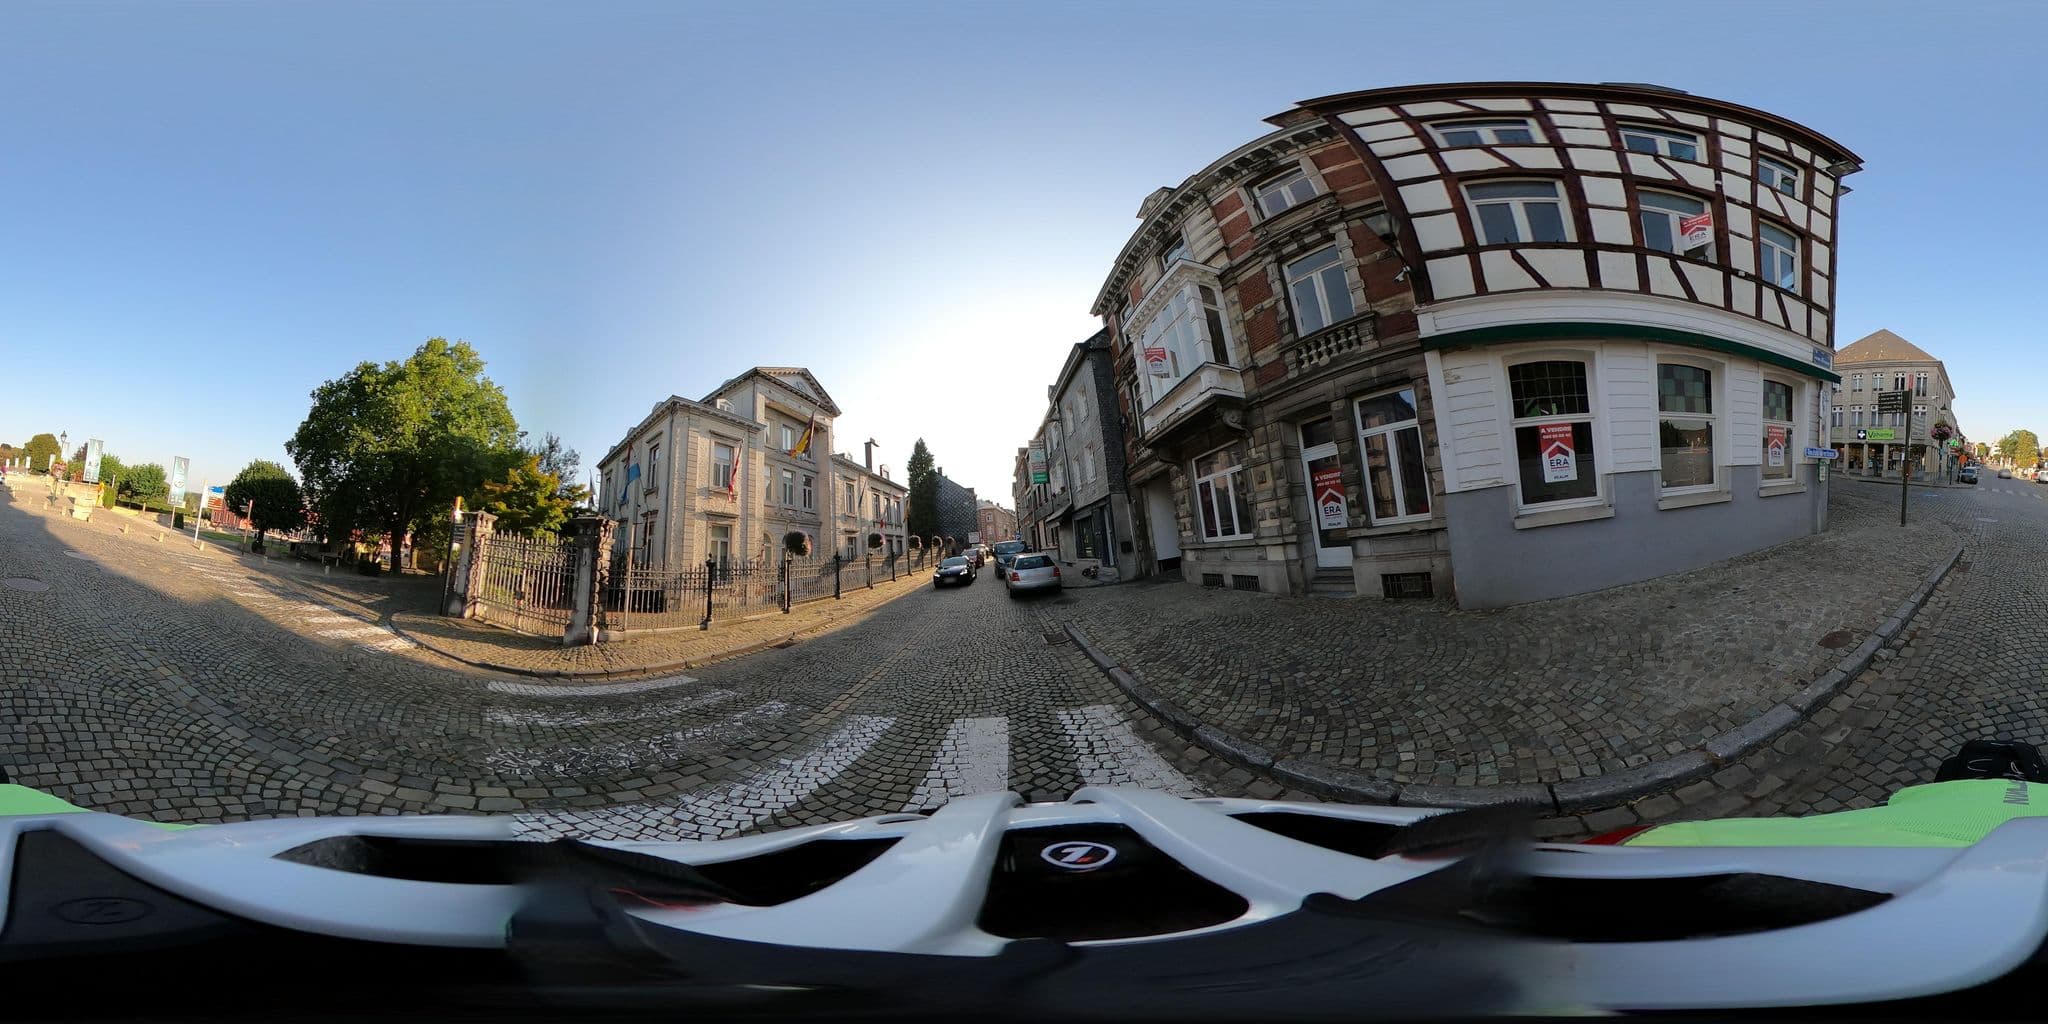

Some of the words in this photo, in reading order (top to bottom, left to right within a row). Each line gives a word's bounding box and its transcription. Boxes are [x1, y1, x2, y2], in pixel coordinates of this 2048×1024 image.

[1689, 232, 1706, 241] ERA
[1549, 458, 1569, 467] ERA
[1323, 505, 1342, 515] ERA
